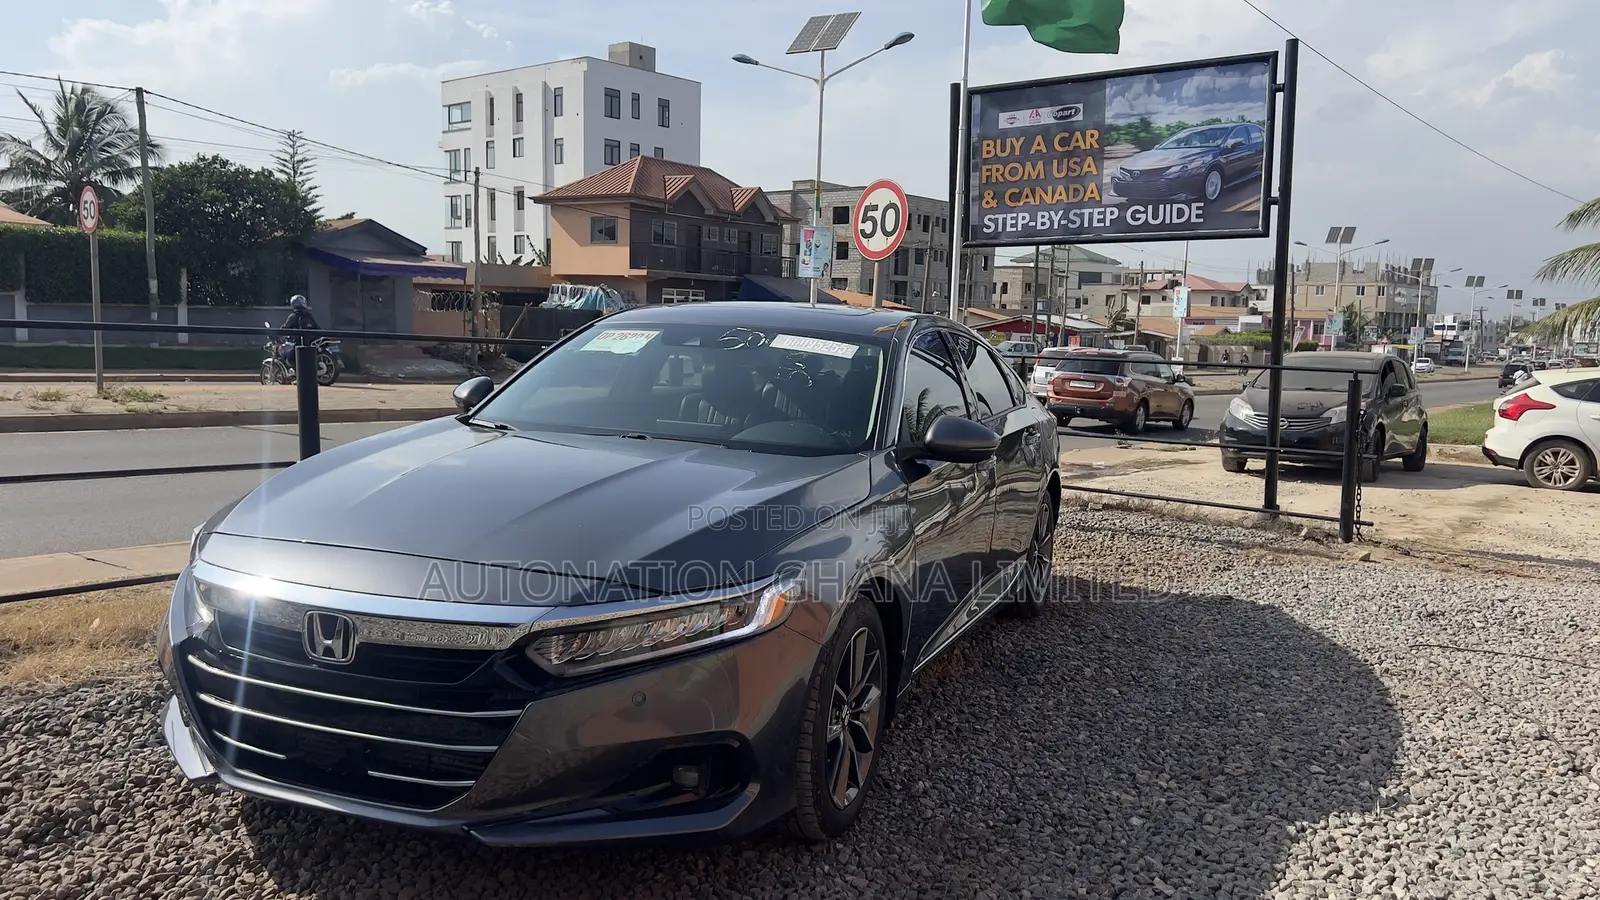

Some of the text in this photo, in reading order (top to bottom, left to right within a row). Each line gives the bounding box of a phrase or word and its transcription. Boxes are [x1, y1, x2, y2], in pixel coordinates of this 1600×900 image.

[982, 129, 1100, 159] BUY A CAR
[981, 156, 1098, 184] FROM USA
[83, 200, 96, 220] 50
[981, 182, 1101, 209] & CANADA
[860, 203, 900, 239] 50
[982, 202, 1204, 233] STEP-BY-STEP GUIDE
